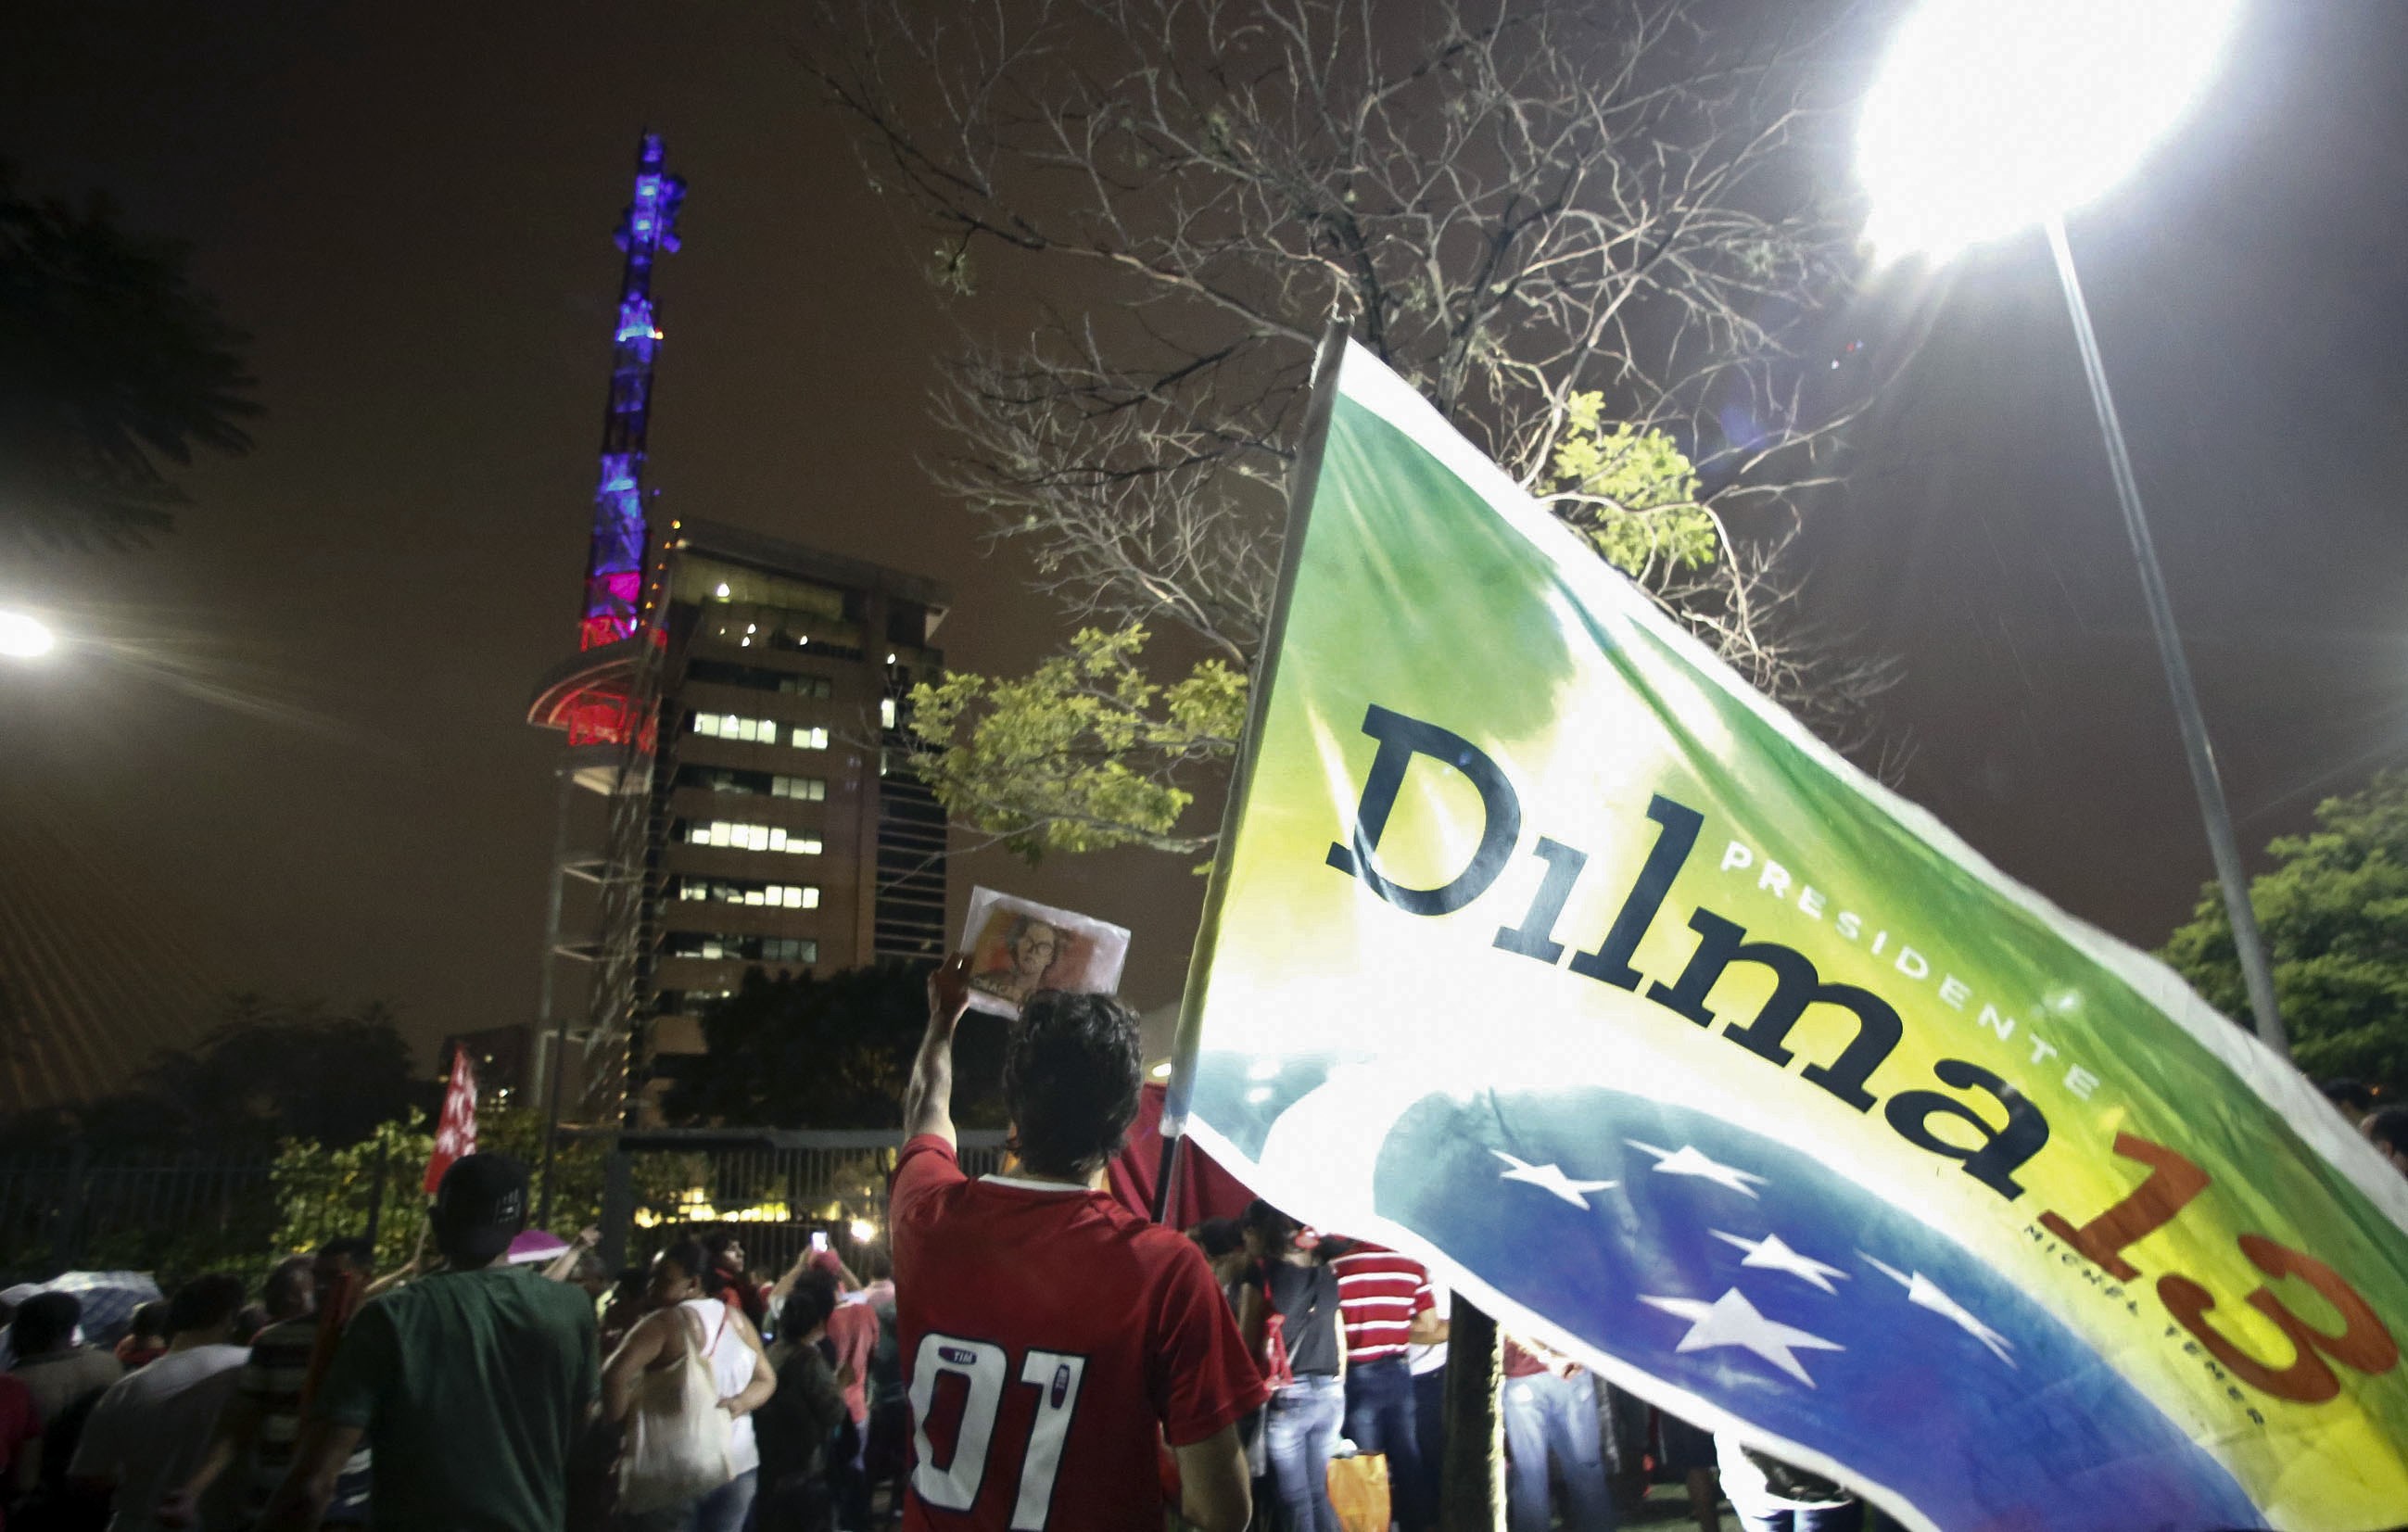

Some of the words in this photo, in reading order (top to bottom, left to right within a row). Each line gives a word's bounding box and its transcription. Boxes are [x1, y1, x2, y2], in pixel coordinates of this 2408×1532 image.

[1721, 840, 2099, 1101] PRESIDENTE
[2036, 1131, 2399, 1405] 13
[907, 1333, 1086, 1531] 01
